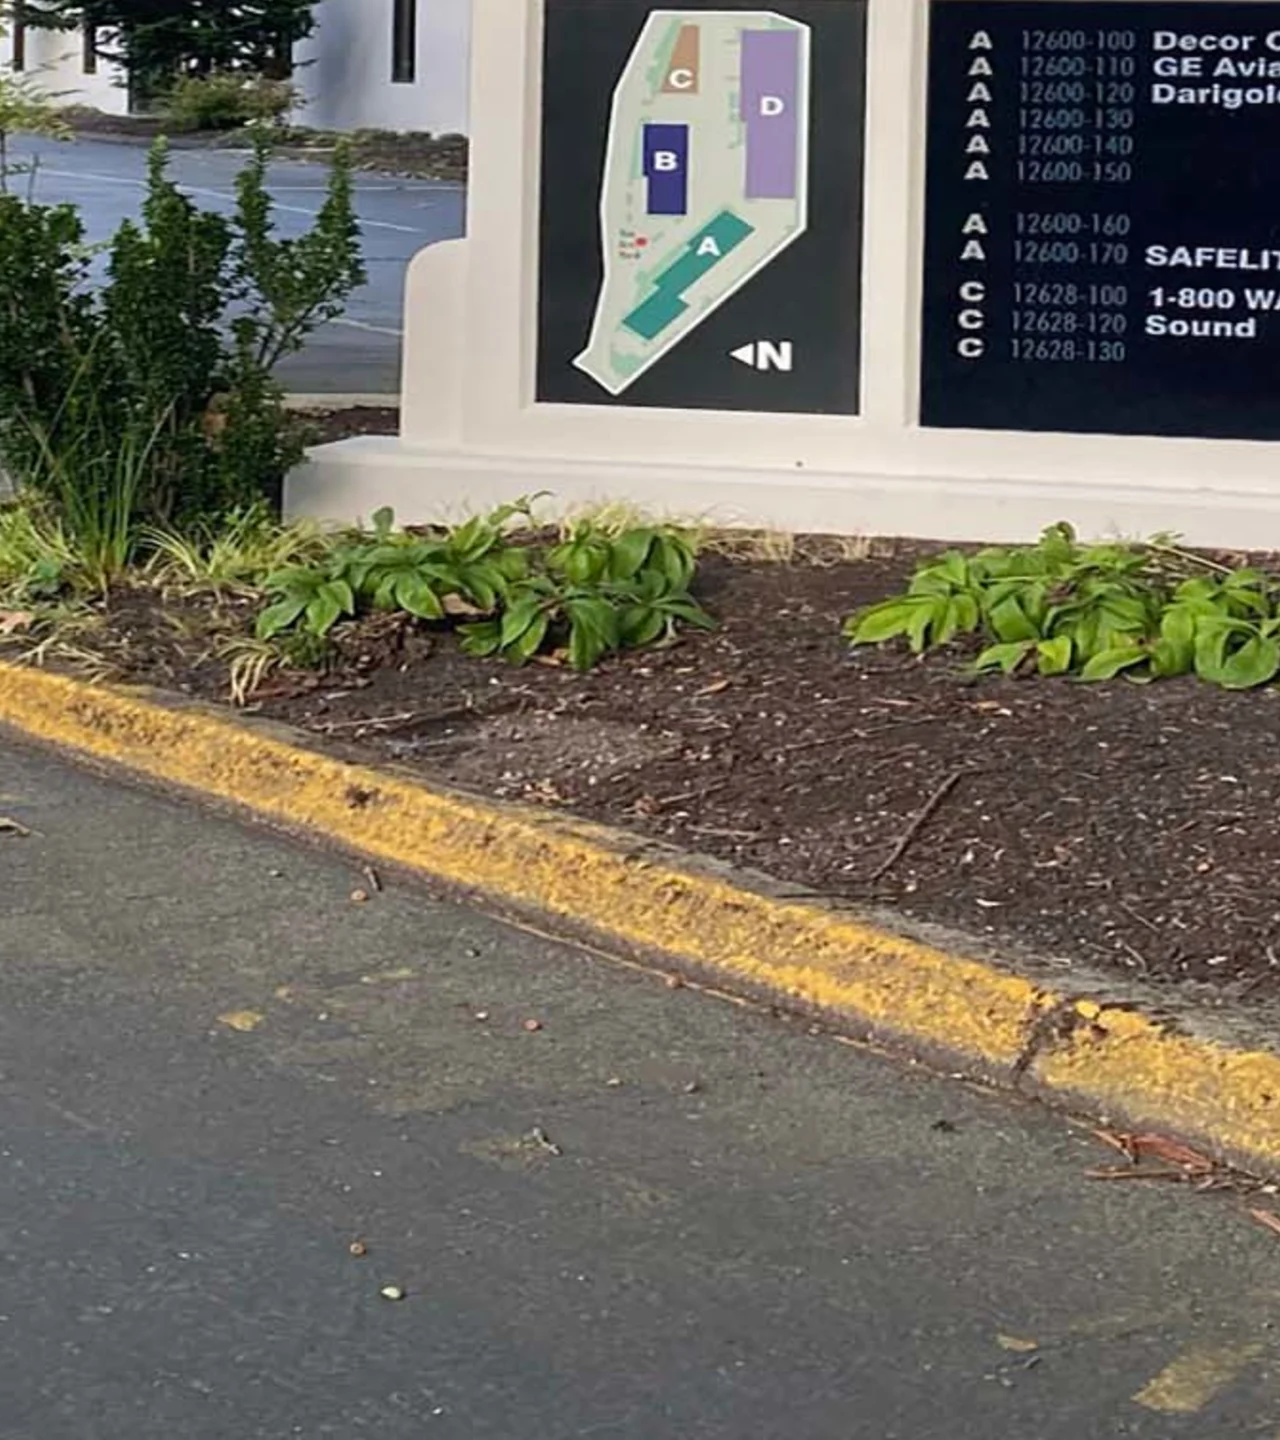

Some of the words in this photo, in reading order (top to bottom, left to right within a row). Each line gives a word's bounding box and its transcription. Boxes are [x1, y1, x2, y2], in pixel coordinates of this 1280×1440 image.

[968, 30, 993, 50] A
[1021, 30, 1136, 51] 12600-100
[1152, 31, 1255, 51] Decor
[968, 56, 993, 76] A
[1020, 57, 1135, 76] 12600-110
[1153, 56, 1203, 76] GE
[668, 68, 694, 88] C
[967, 82, 992, 102] A
[1020, 82, 1135, 102] 12600-120
[760, 96, 784, 116] D
[965, 109, 991, 128] A
[1020, 109, 1134, 128] 12600-130
[964, 135, 990, 154] A
[1019, 135, 1133, 155] 12600-140
[653, 151, 678, 171] B
[964, 161, 989, 180] A
[1018, 162, 1132, 181] 12600-150
[961, 213, 988, 234] A
[1016, 213, 1131, 235] 12600-160
[695, 236, 720, 257] A
[960, 240, 986, 260] A
[1014, 240, 1129, 263] 12600-170
[959, 281, 986, 302] C
[1013, 282, 1128, 305] 12628-100
[1149, 287, 1235, 309] 1-800
[958, 309, 985, 329] C
[1012, 311, 1126, 333] 12628-120
[1144, 314, 1256, 338] Sound
[757, 340, 792, 371] N
[958, 338, 984, 358] C
[1011, 339, 1125, 361] 12628-130
